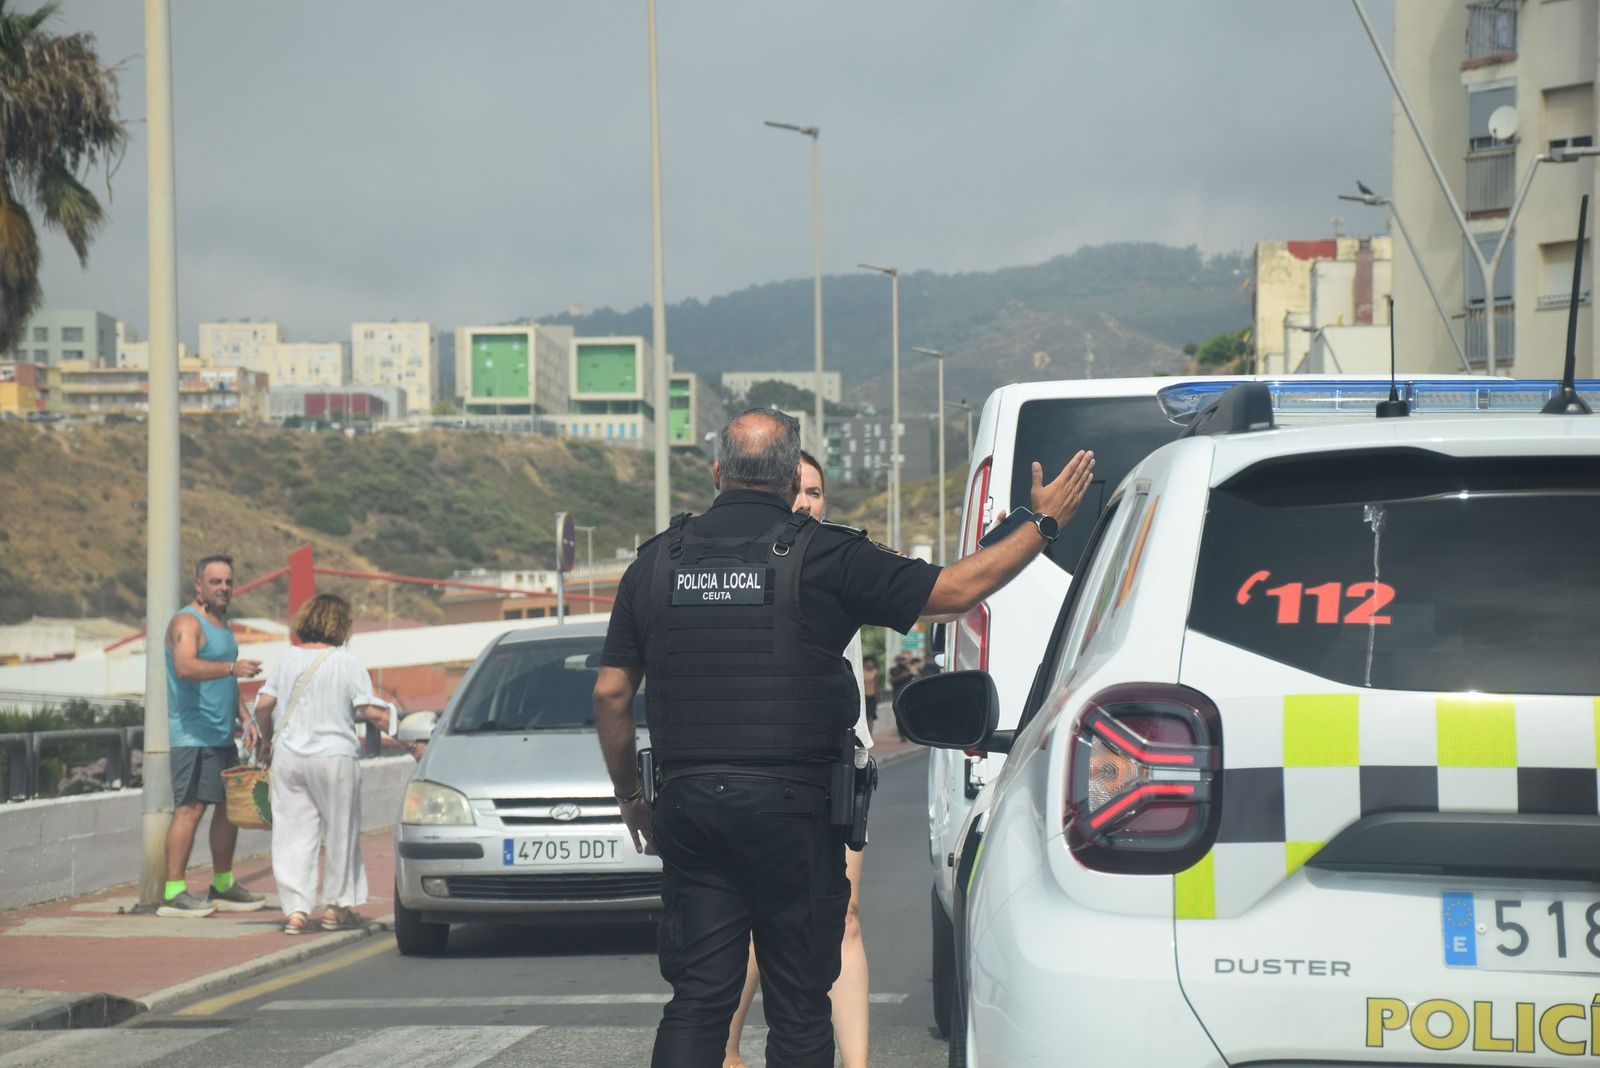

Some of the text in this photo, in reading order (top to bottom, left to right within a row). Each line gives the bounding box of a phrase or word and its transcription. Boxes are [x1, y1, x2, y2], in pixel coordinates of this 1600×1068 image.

[677, 572, 761, 590] POLICIA LOCAL
[702, 591, 731, 600] CEUTA
[1265, 581, 1397, 624] 112
[518, 841, 570, 860] 4705
[579, 840, 618, 859] DDT
[1453, 936, 1467, 952] E
[1214, 958, 1352, 977] DUSTER
